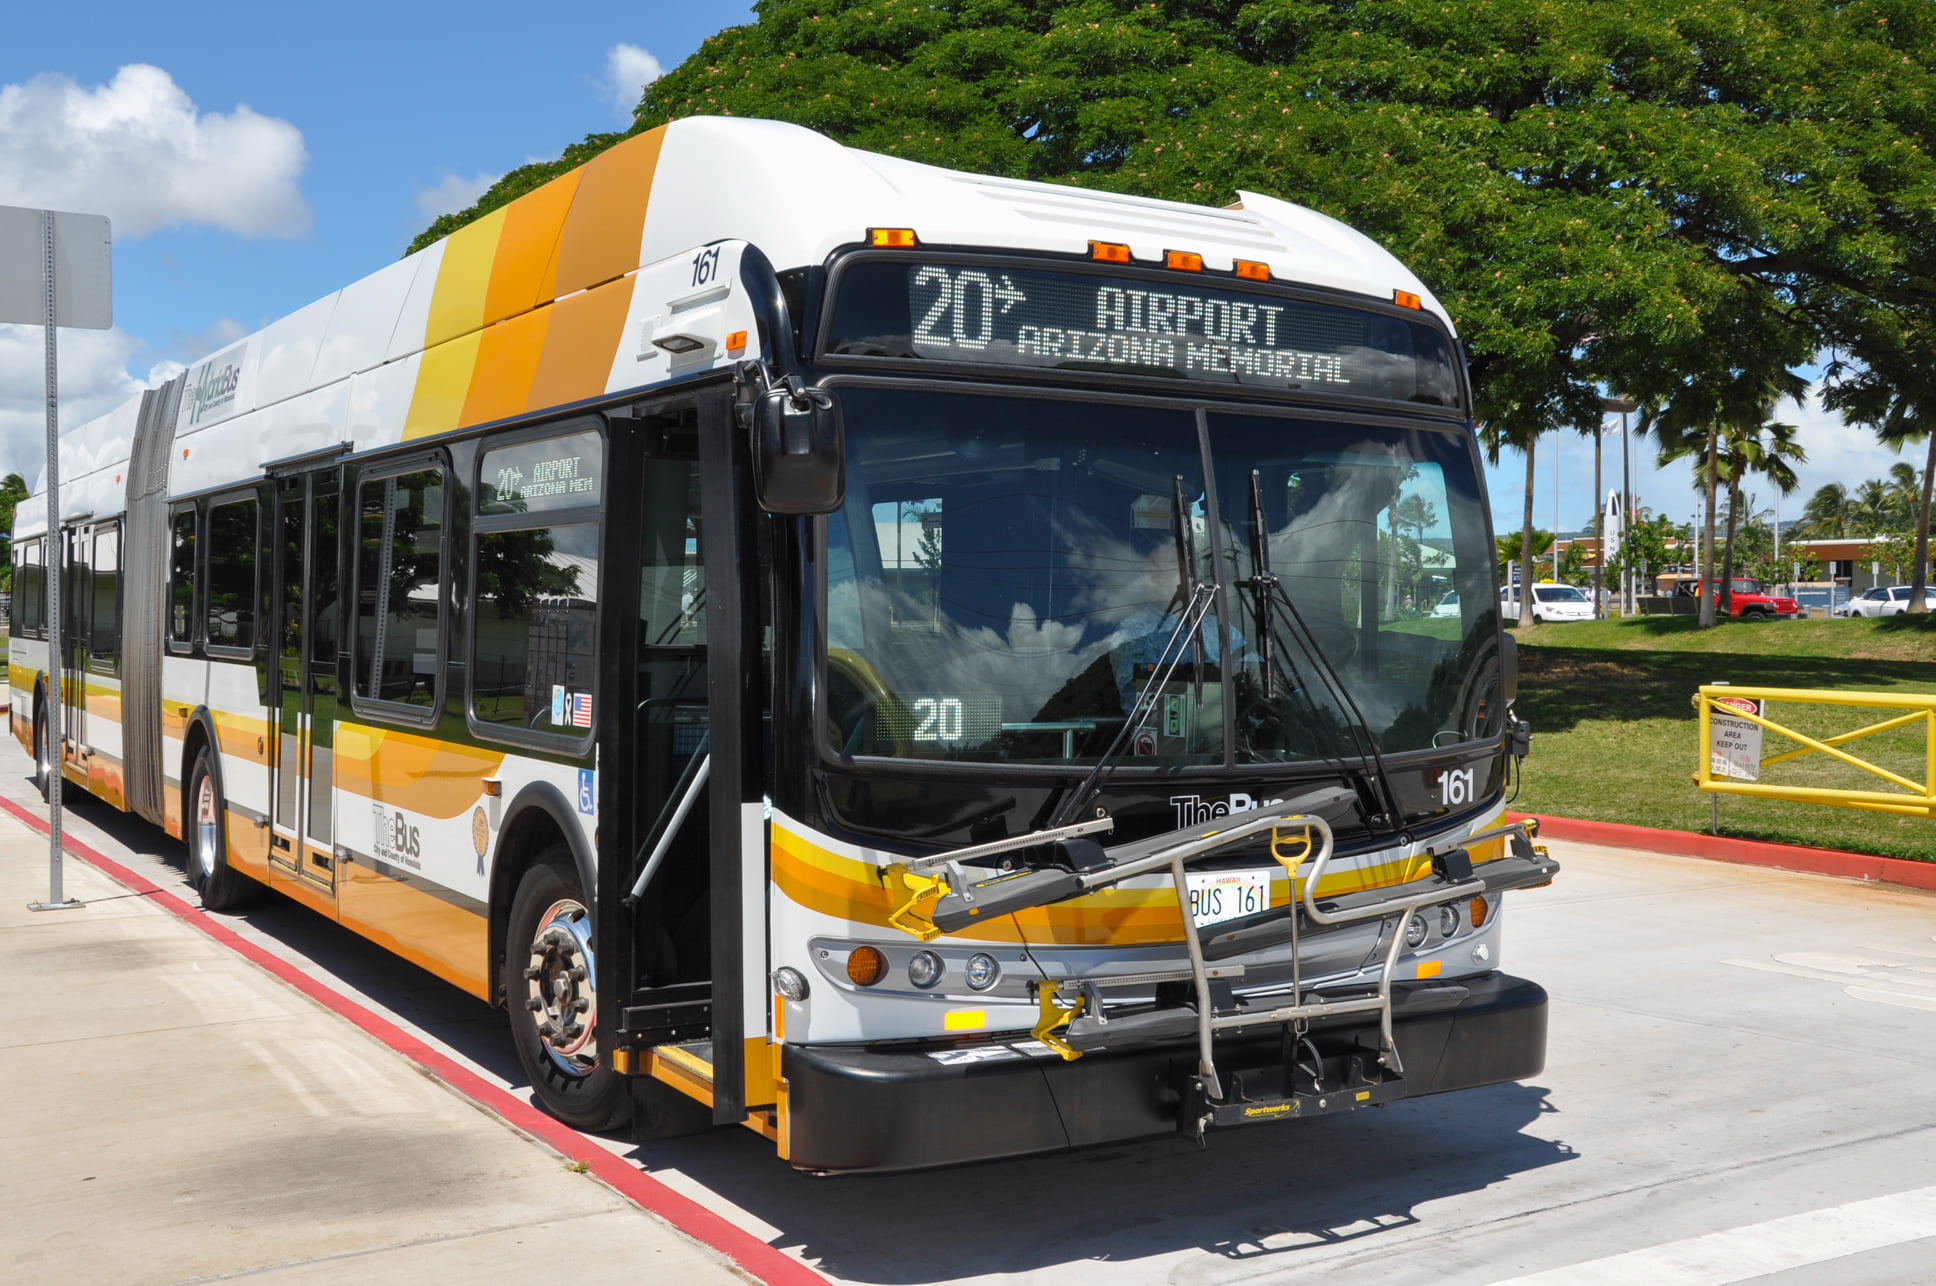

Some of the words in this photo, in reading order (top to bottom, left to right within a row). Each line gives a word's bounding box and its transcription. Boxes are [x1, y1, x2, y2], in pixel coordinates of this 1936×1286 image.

[692, 246, 720, 287] 161
[914, 266, 992, 350] 20
[1097, 286, 1284, 346] AIRPORT
[1018, 325, 1174, 367] ARIZONA
[1186, 342, 1351, 384] MEMORIAL
[496, 467, 514, 501] 20
[533, 456, 581, 483] AIRPORT
[520, 480, 566, 499] ARIZONA
[569, 477, 593, 493] MEM
[914, 698, 962, 741] 20
[1721, 700, 1752, 712] ANGER
[1710, 717, 1759, 731] CONSTRUCTION
[1724, 730, 1741, 739] AREA
[1716, 740, 1733, 748] KEEP
[1734, 742, 1748, 751] OUT
[1437, 768, 1474, 805] 161
[1190, 888, 1222, 917] BUS
[1237, 885, 1264, 913] 161
[1244, 1103, 1290, 1116] Sportworks
